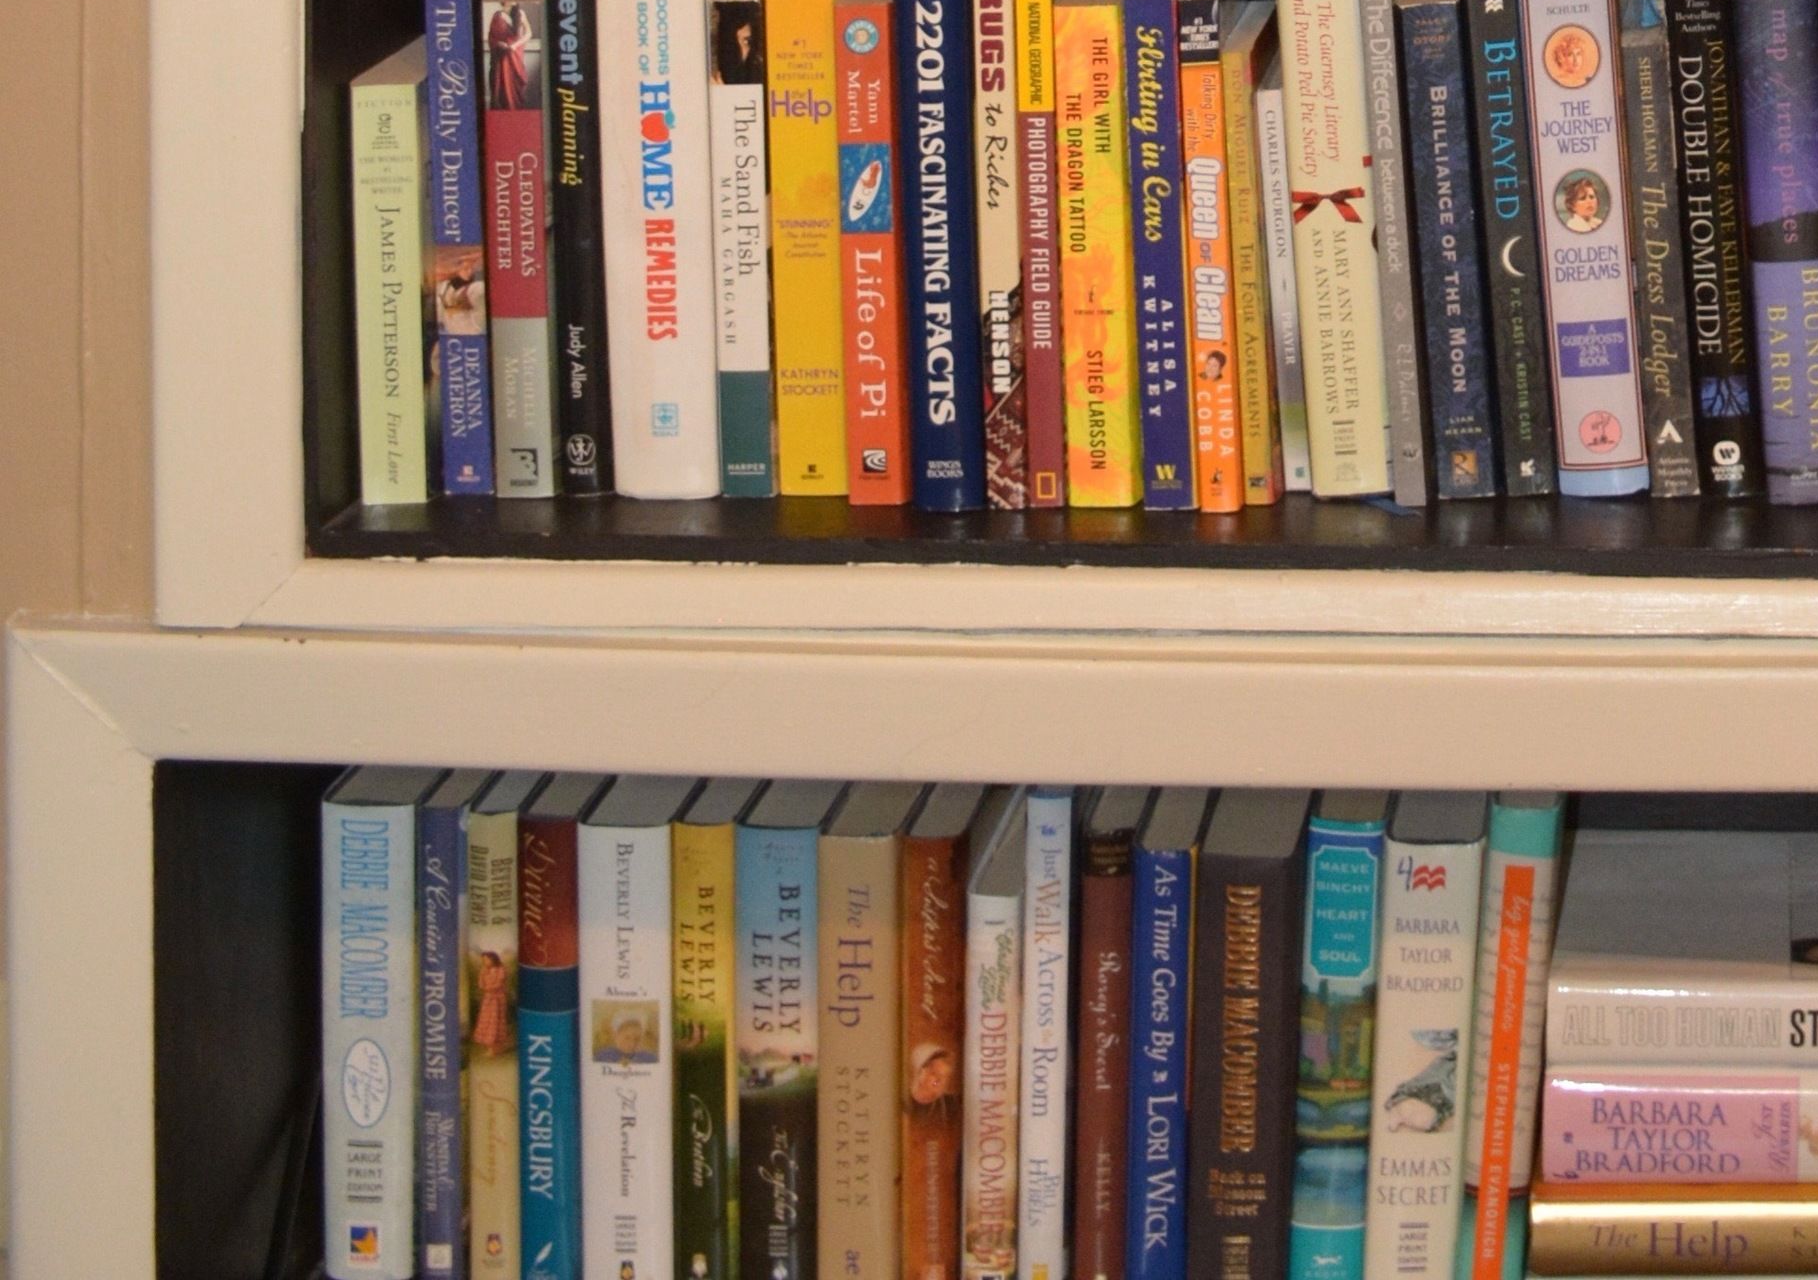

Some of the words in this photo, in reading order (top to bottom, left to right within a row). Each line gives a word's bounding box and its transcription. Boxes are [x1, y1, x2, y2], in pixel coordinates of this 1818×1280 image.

[914, 0, 944, 94] 2201
[770, 89, 832, 123] Help
[1484, 40, 1520, 220] BETRAYED
[1541, 116, 1613, 138] JOURNEY
[1560, 101, 1592, 118] THE
[1557, 135, 1598, 154] WEST
[918, 102, 953, 294] FASCINATING
[1026, 117, 1048, 242] PHOTOGRAPHY
[645, 219, 677, 341] REMEDIES
[854, 249, 885, 324] Life
[1031, 247, 1050, 304] FIELD
[1033, 309, 1052, 350] GUIDE
[925, 302, 955, 426] FACTS
[1087, 350, 1103, 397] STIEG
[859, 380, 886, 417] Pi
[1088, 402, 1106, 470] LARSSON
[616, 843, 634, 922] BEVERLY
[616, 926, 634, 979] LEWIS
[828, 937, 874, 1028] Help
[528, 1034, 554, 1200] KINGSBURY
[1146, 1094, 1177, 1163] LORI
[1591, 1098, 1727, 1127] BARBARA
[1607, 1126, 1715, 1152] TAYLOR
[1379, 1158, 1451, 1178] EMMA'S
[1574, 1150, 1742, 1174] BRADFORD
[1146, 1168, 1176, 1249] WICK
[1377, 1184, 1451, 1205] SECRET
